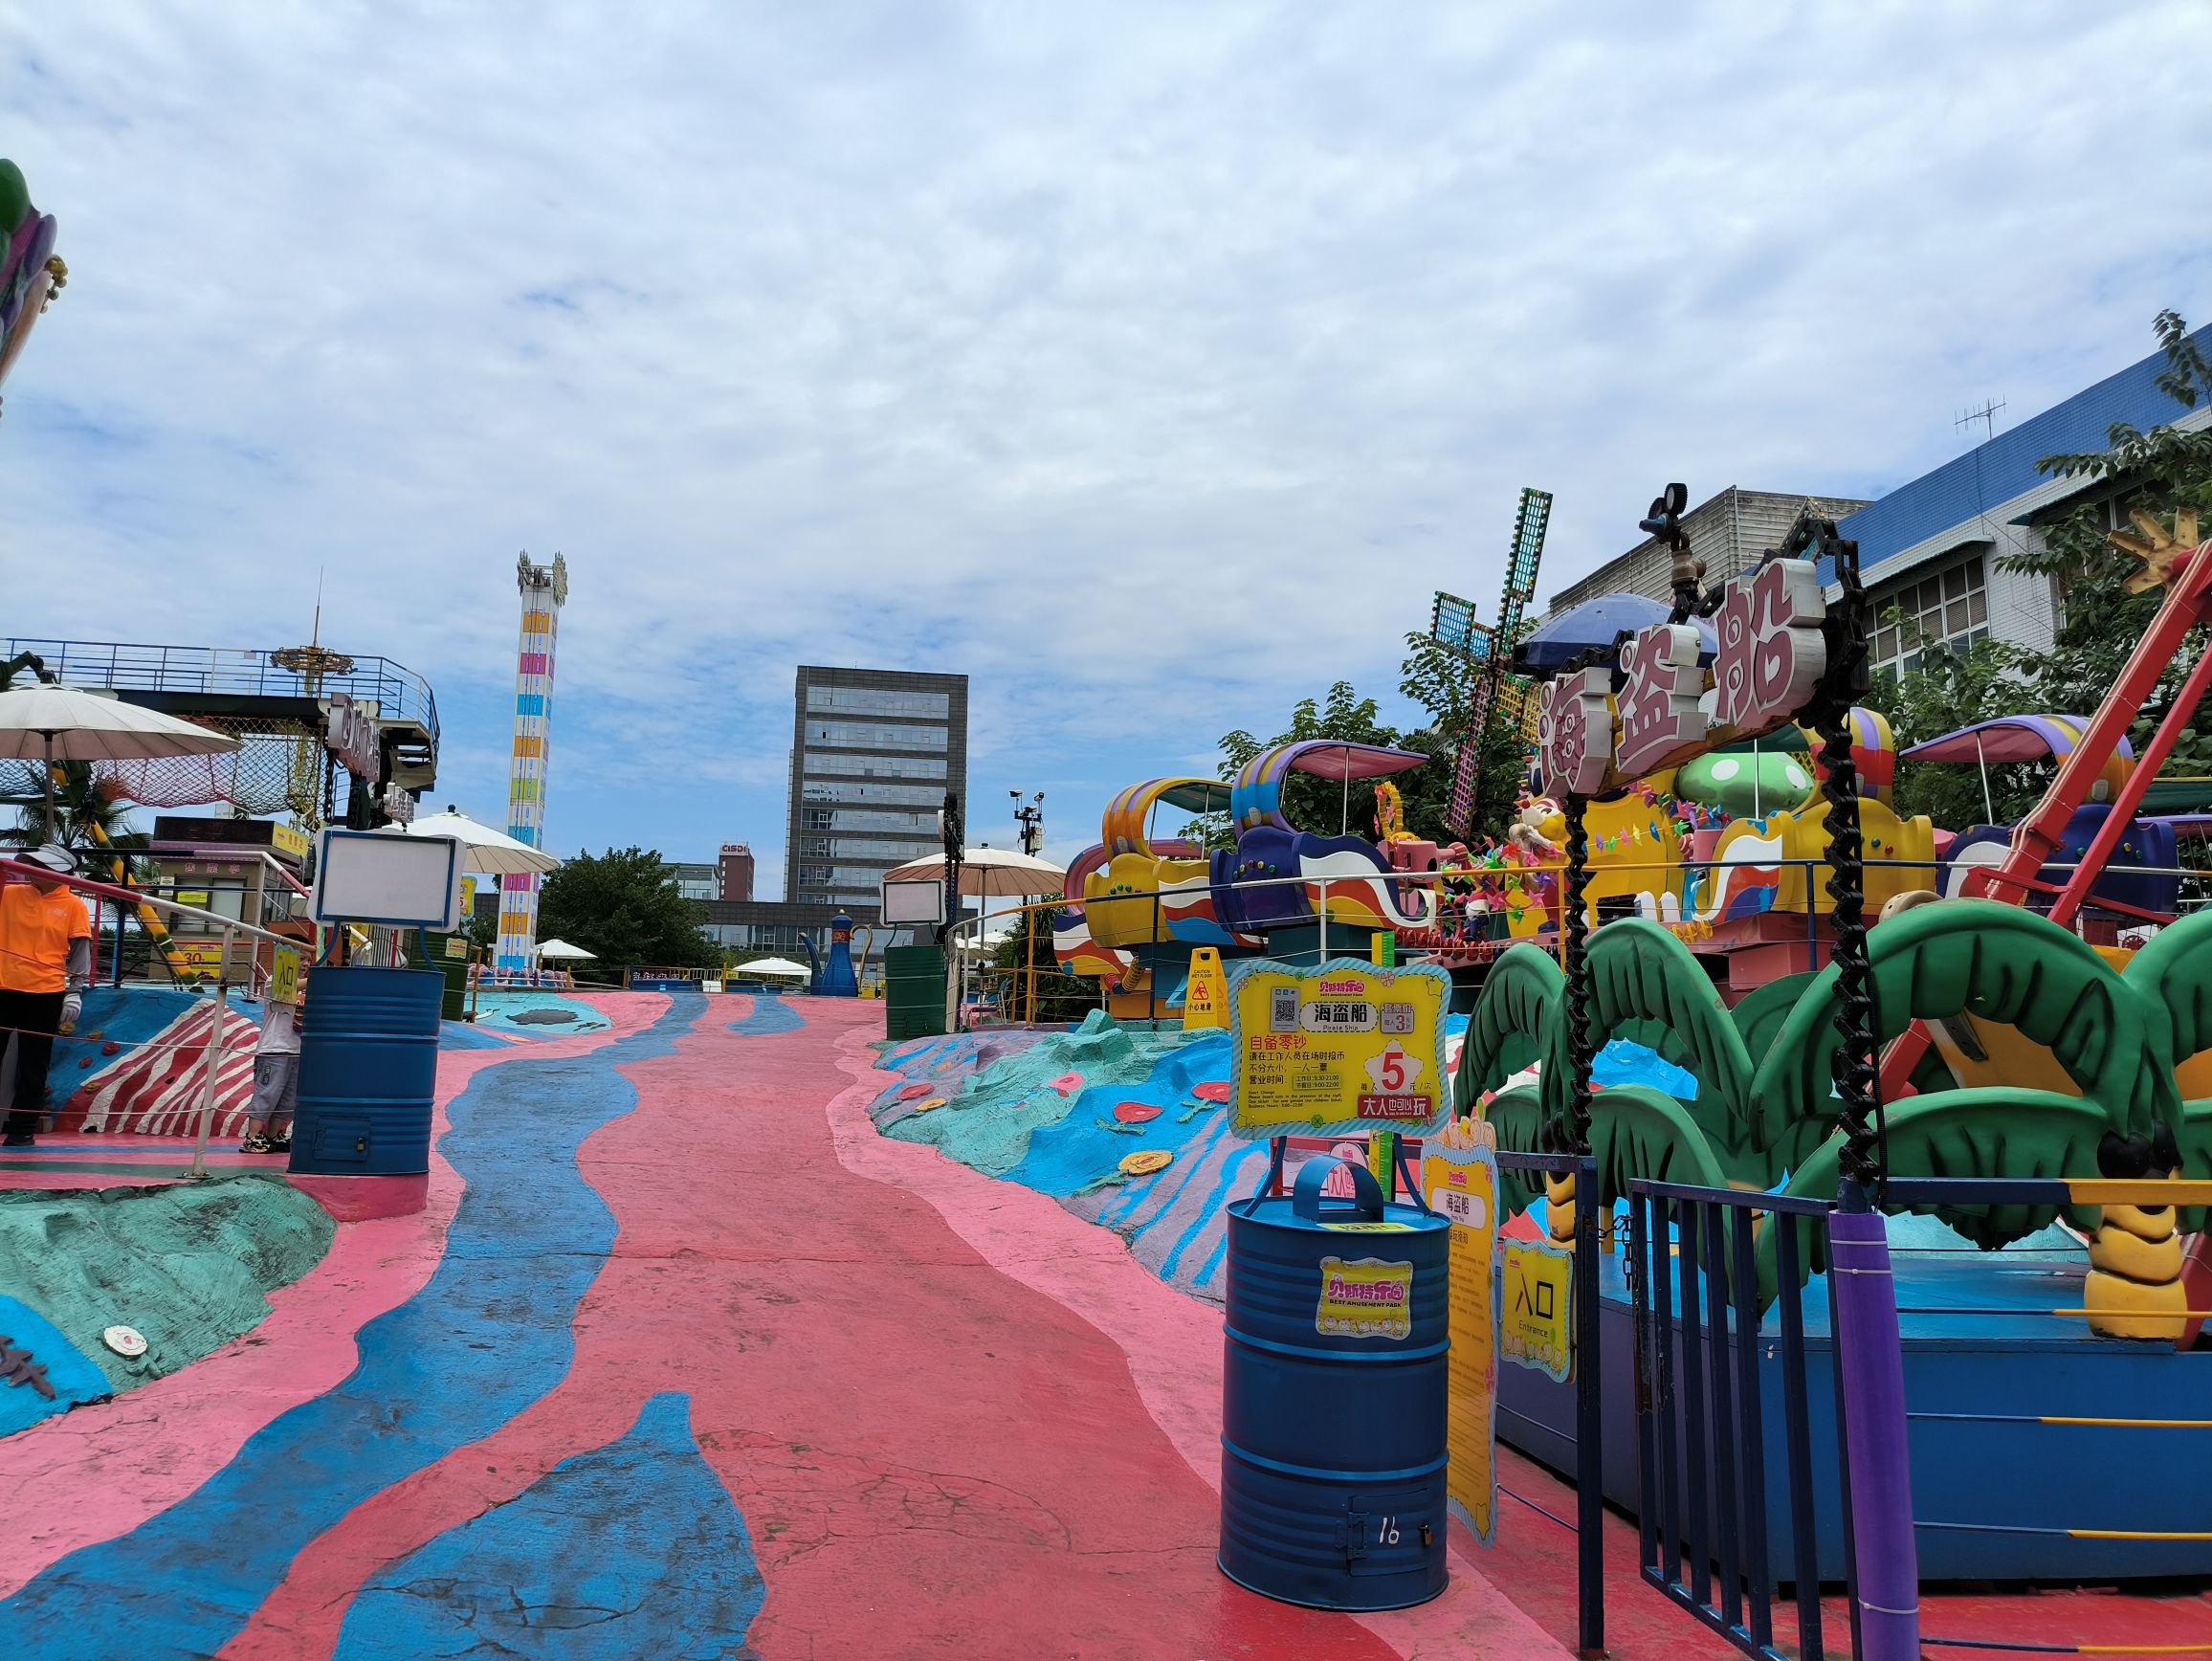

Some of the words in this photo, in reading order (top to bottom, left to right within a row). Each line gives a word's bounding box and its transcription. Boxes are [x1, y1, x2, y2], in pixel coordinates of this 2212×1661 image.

[1538, 558, 1796, 794] 海盗船
[279, 963, 294, 986] 入口
[1315, 1005, 1367, 1022] 海盗船
[1396, 1015, 1405, 1030] 3
[1250, 1035, 1307, 1050] 自备零钞
[1249, 1052, 1344, 1061] 请在工作人员在场时投币
[1382, 1052, 1405, 1090] 5
[1363, 1097, 1427, 1115] 大人也可以玩
[1446, 1192, 1470, 1215] 海盗船
[1328, 1278, 1405, 1301] 贝斯特乐园
[1515, 1273, 1554, 1320] 入口
[1518, 1320, 1549, 1339] Entrance
[1379, 1516, 1400, 1544] 16
